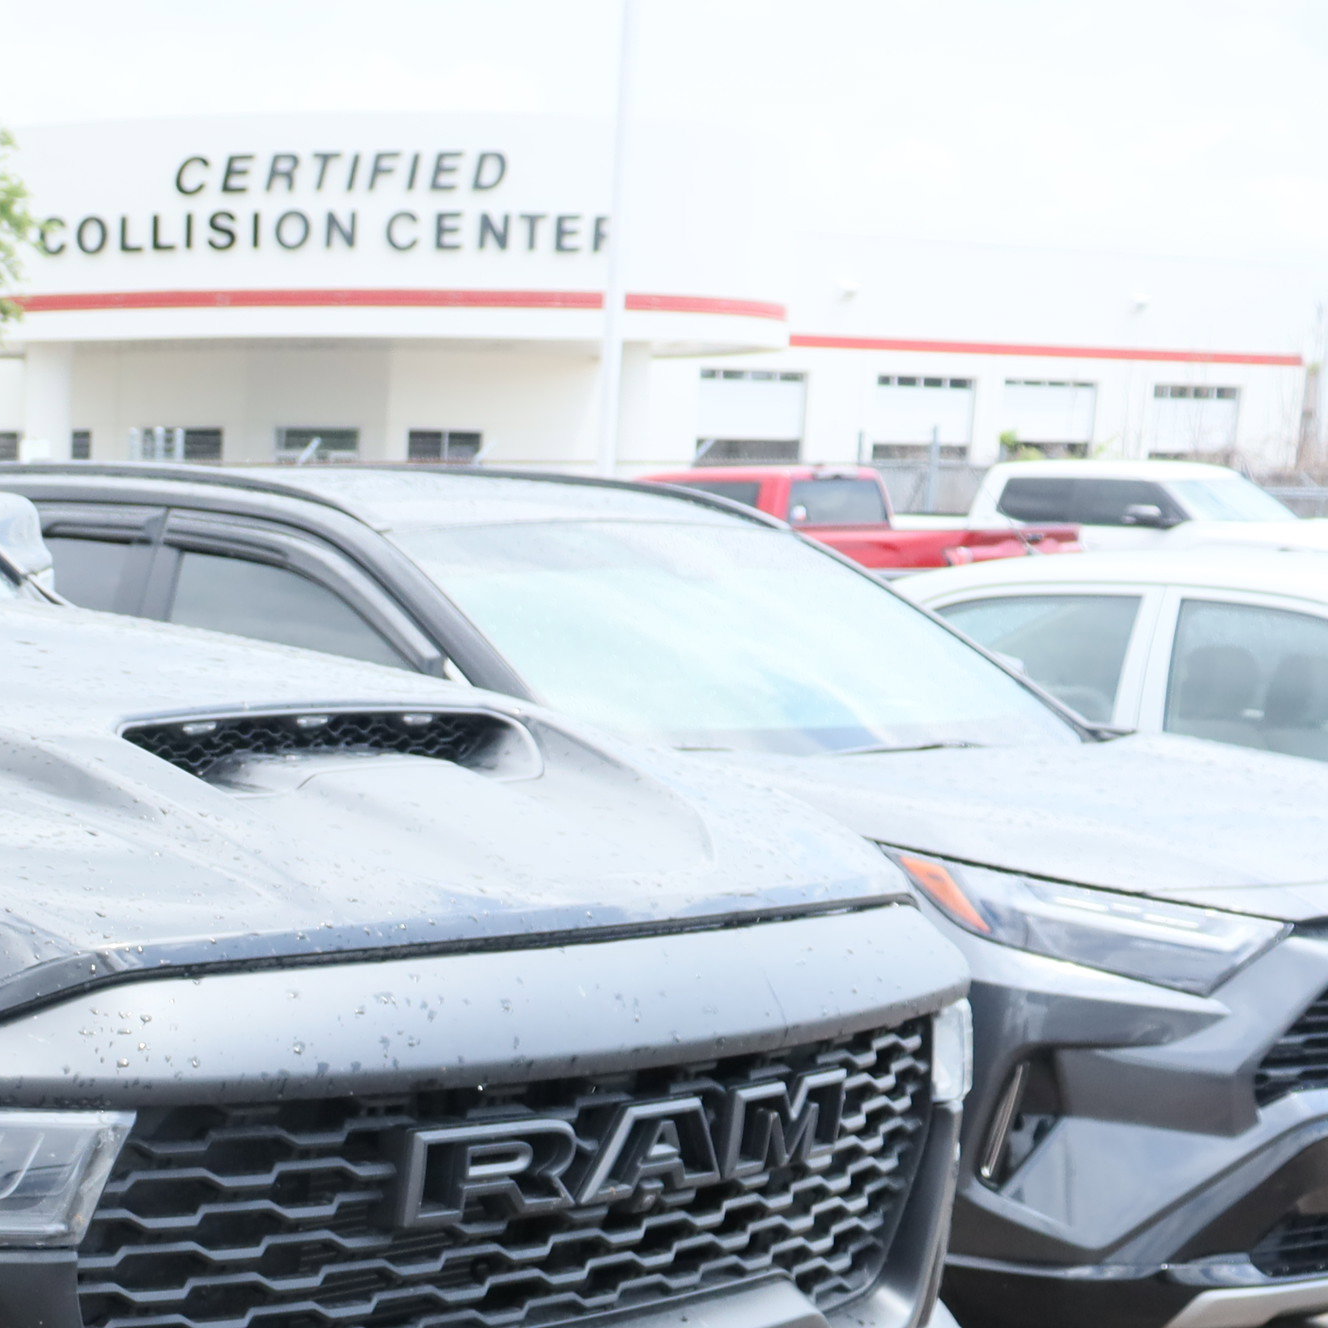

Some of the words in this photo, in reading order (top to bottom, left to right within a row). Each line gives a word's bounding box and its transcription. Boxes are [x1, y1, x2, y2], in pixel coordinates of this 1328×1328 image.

[174, 150, 508, 195] CERTIFIED
[38, 211, 358, 256] COLLISION
[404, 1068, 847, 1227] RAM
